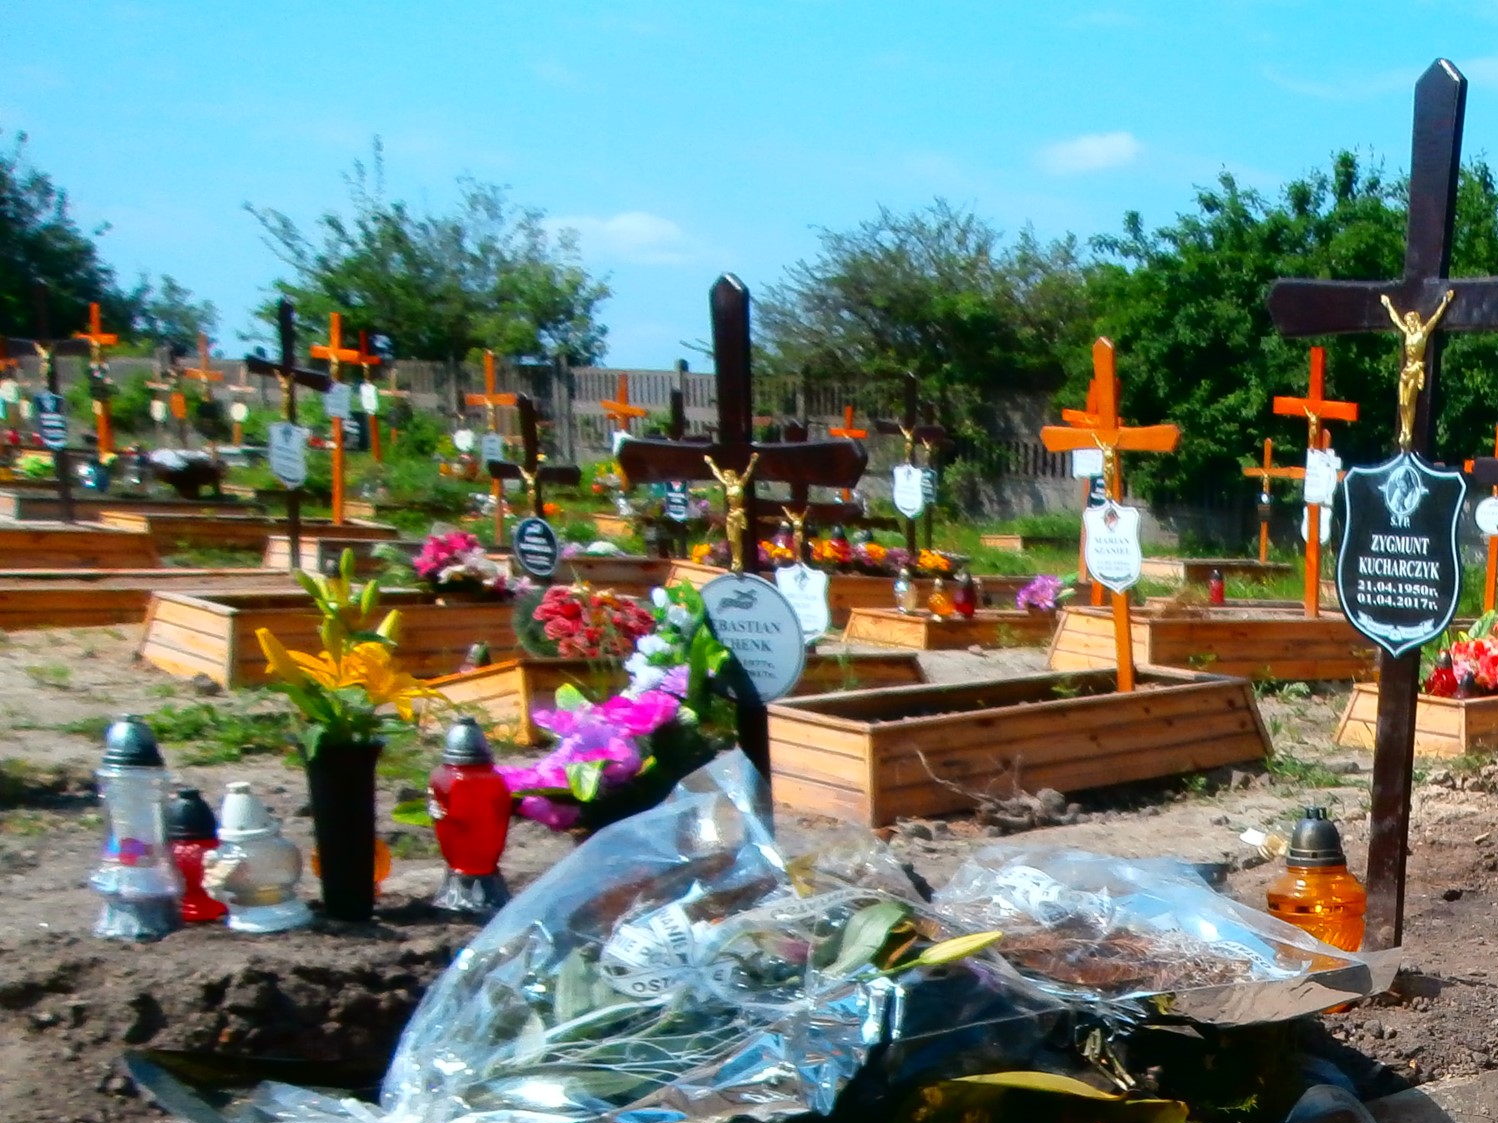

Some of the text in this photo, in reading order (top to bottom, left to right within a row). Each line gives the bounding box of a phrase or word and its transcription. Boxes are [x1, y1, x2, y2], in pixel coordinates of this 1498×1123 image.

[1370, 534, 1430, 556] ZYGMUNT
[1358, 557, 1440, 580] KUCHARCZYK
[1357, 579, 1438, 597] 21.04.1950r.
[1357, 592, 1438, 610] 01.04.2017r.
